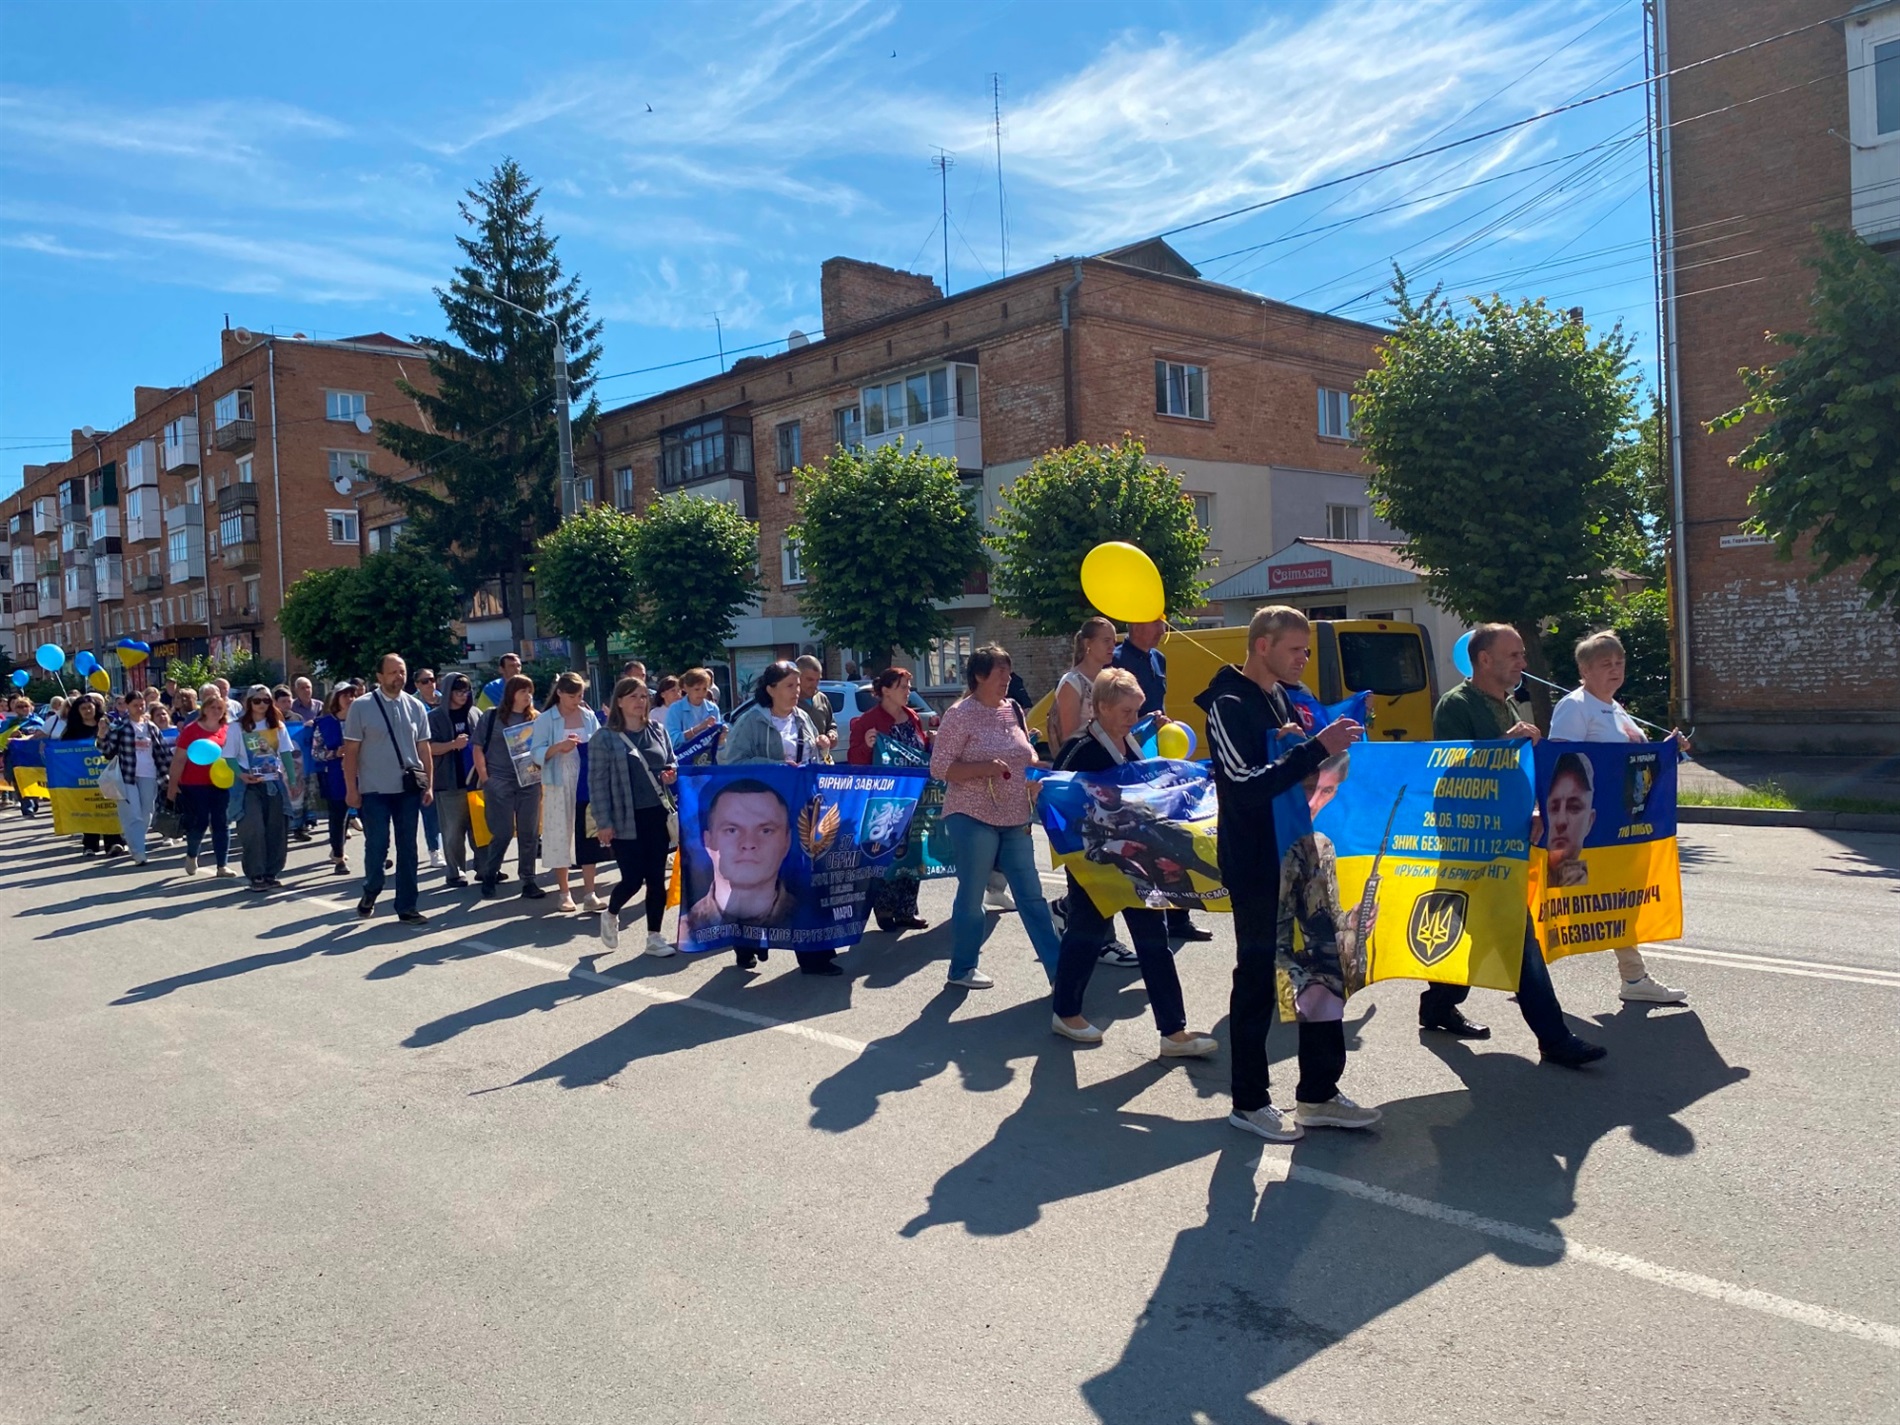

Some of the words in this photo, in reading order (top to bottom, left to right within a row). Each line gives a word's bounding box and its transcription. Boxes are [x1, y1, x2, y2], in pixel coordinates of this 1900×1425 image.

[1272, 567, 1328, 584] Світлана
[1426, 747, 1473, 768] ГУЛЯК
[1469, 748, 1520, 770] БОГДАН
[818, 775, 854, 790] ВІРНИЙ
[854, 778, 895, 791] ЗАВЖДИ
[1433, 777, 1499, 800] ІВАНОВИЧ
[1392, 835, 1418, 851] ЗНИК
[1421, 835, 1469, 853] БЕЗВІСТИ
[1440, 866, 1447, 879] 4
[1486, 864, 1511, 880] НГУ
[1572, 885, 1661, 915] ВІТАЛІЙОВИЧ
[1560, 919, 1627, 946] БЕЗВІСТИ!
